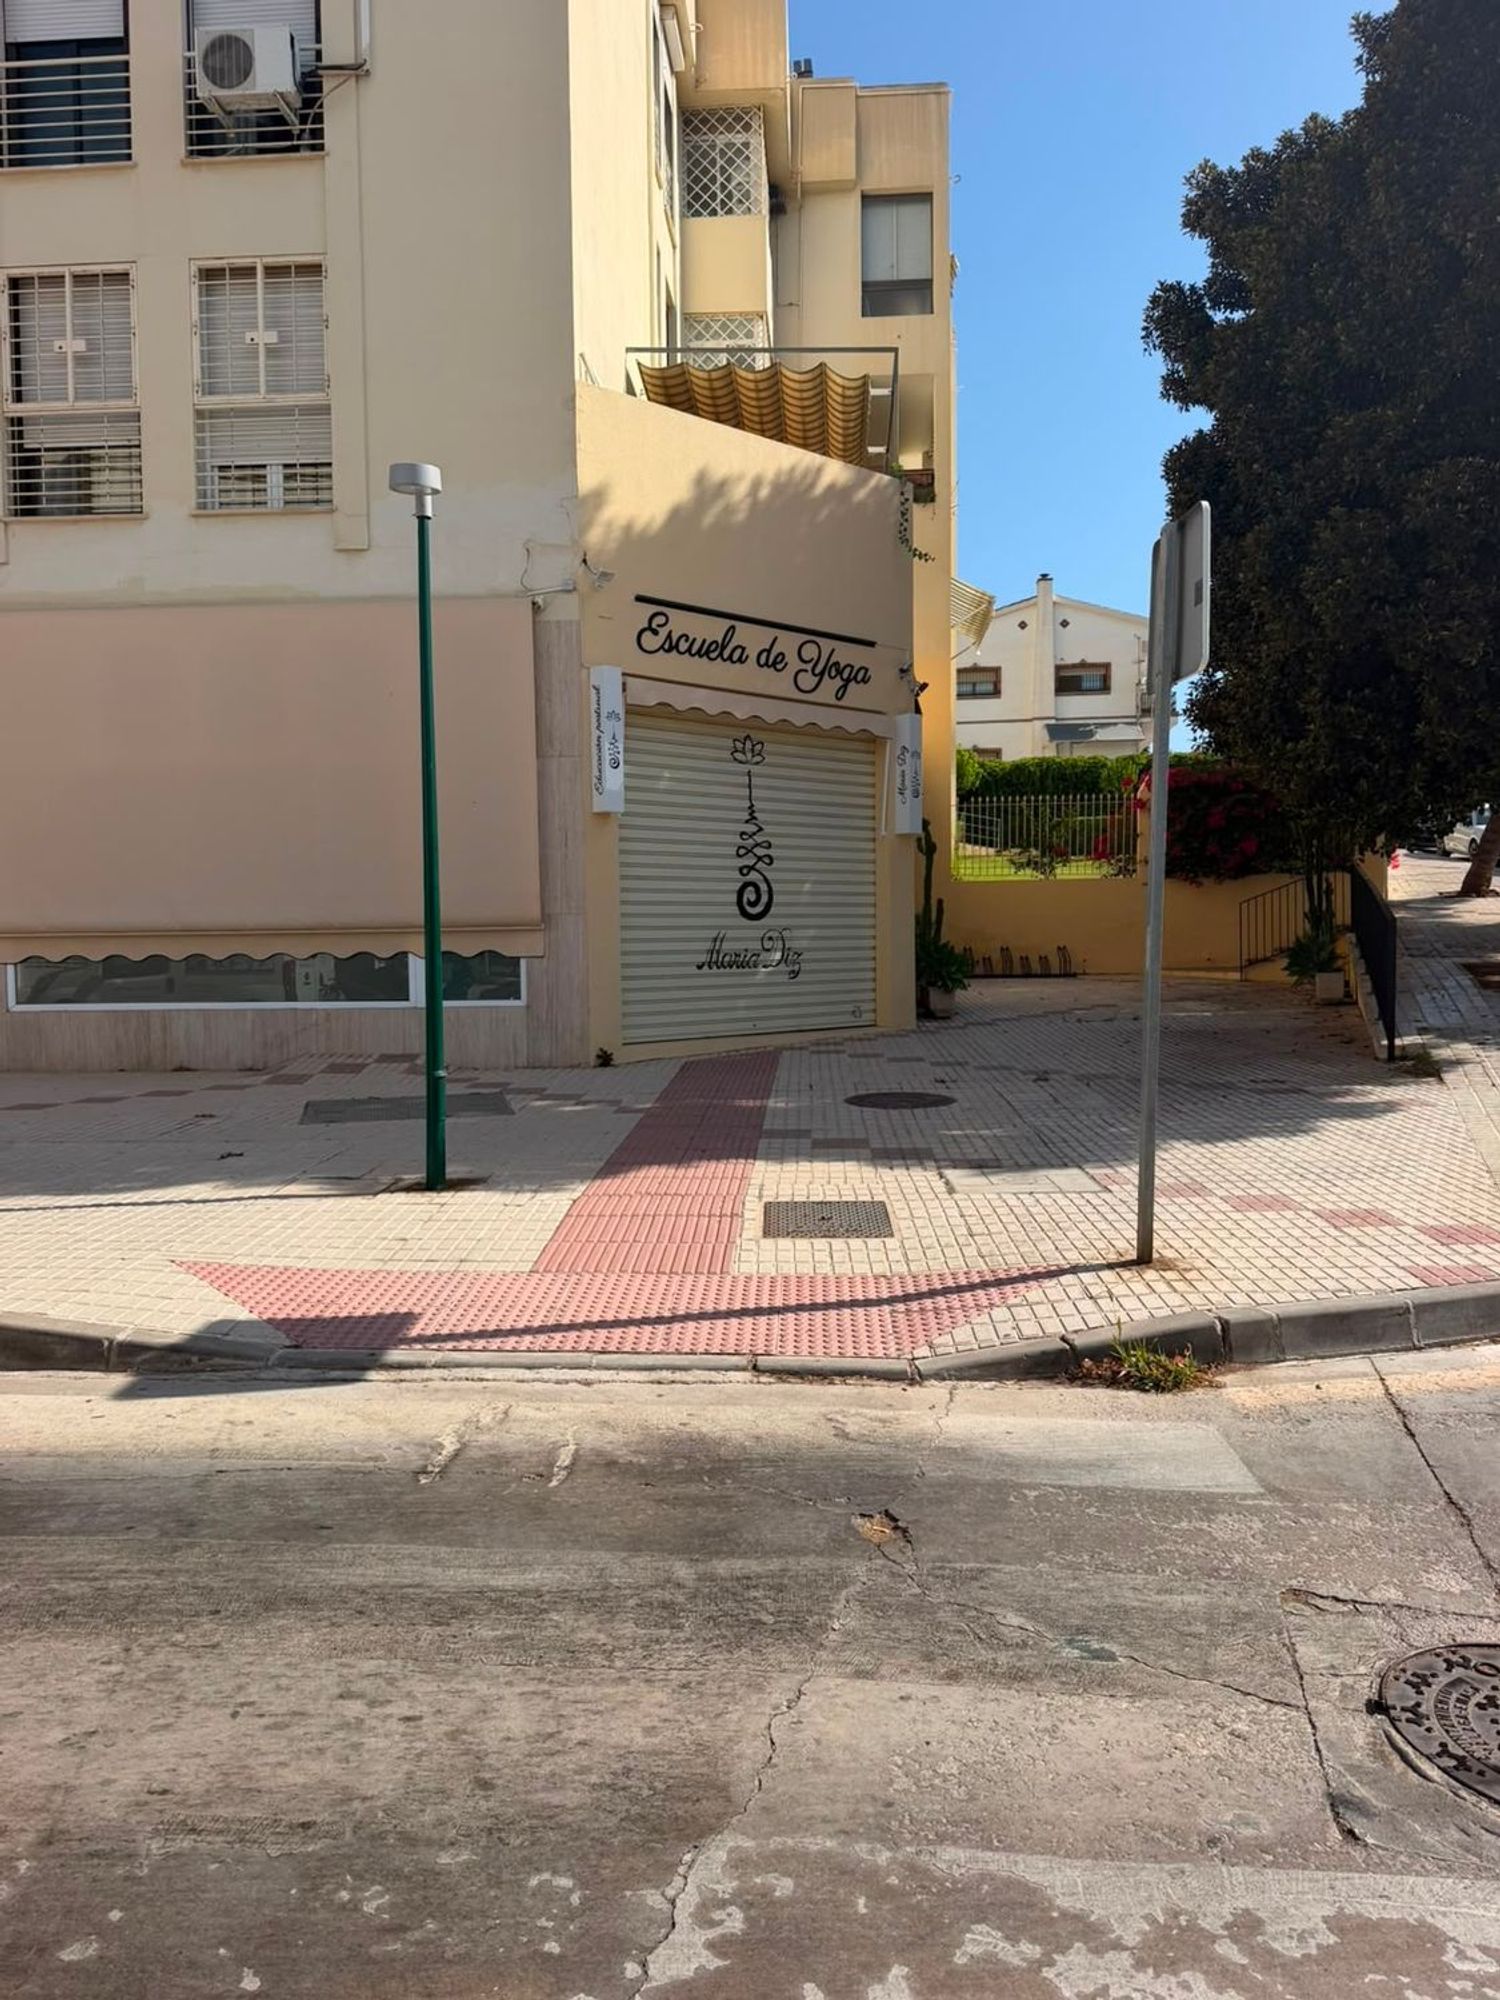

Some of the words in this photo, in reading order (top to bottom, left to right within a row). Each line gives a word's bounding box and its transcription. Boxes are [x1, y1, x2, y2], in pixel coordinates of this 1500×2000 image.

[636, 611, 749, 664] Escuela
[756, 636, 788, 672] de
[793, 640, 871, 701] Yoga
